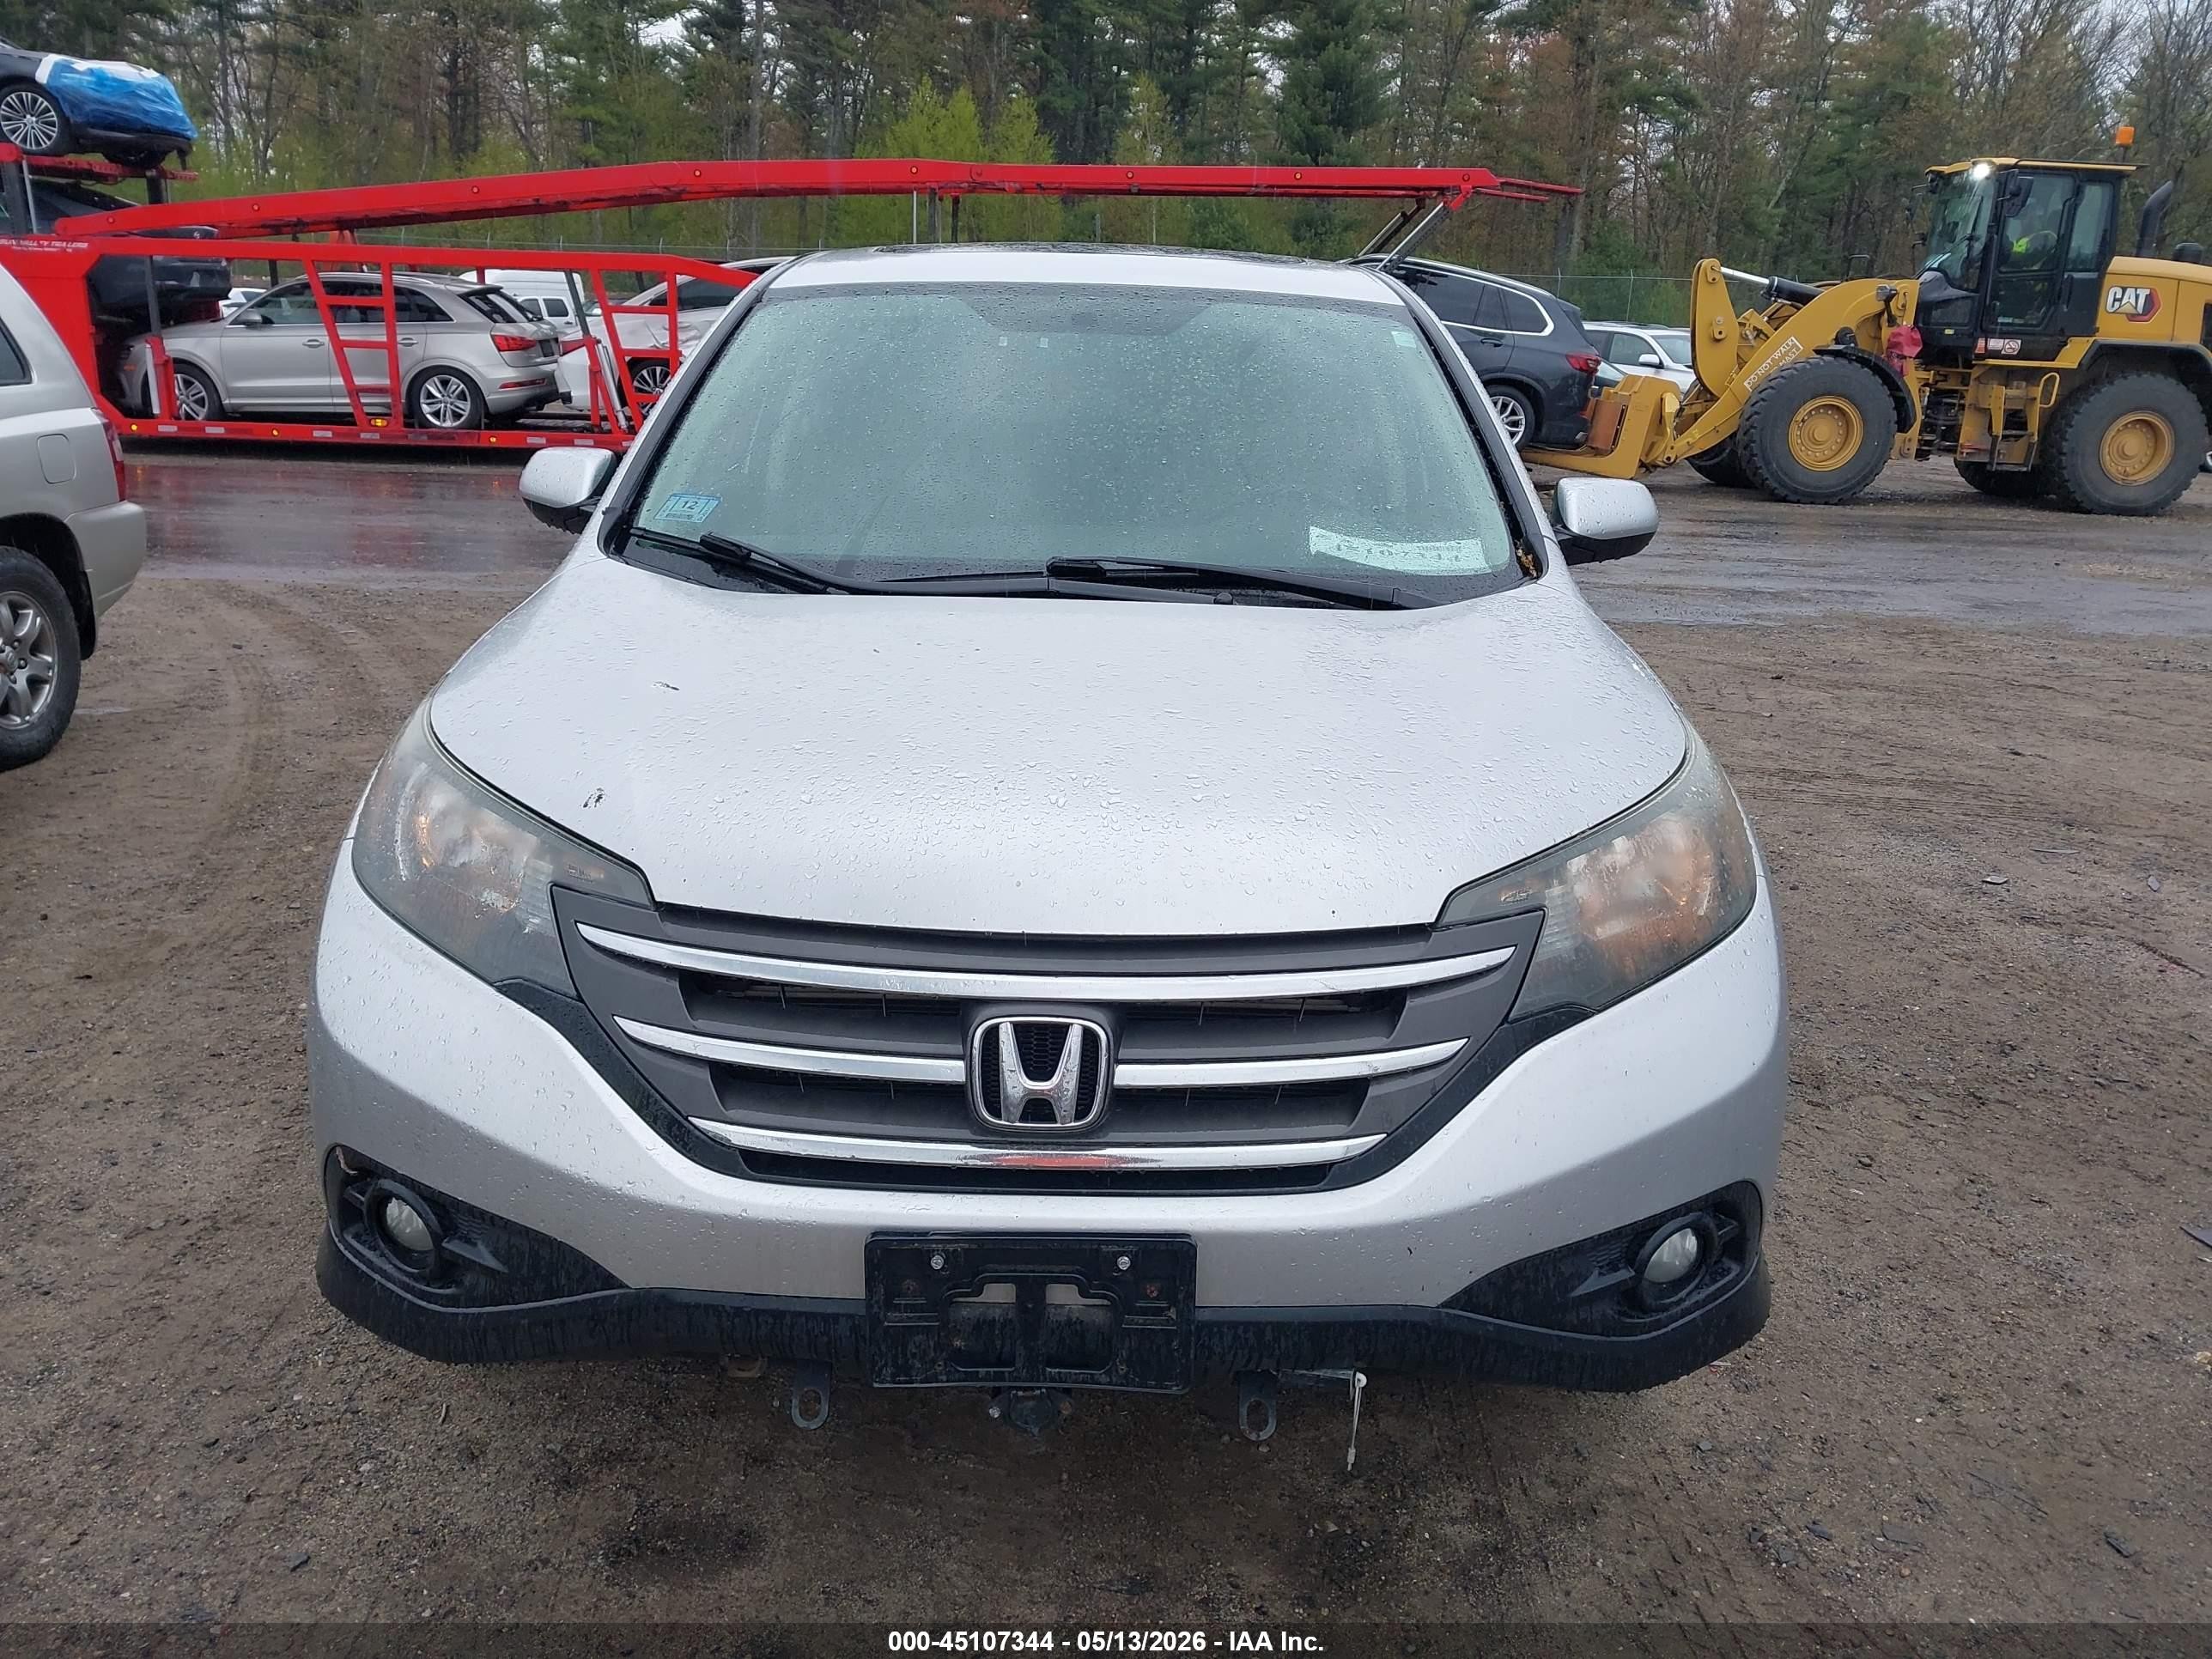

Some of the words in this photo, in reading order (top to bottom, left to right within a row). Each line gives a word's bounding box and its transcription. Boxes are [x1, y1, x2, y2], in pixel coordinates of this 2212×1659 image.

[2106, 286, 2151, 314] CAT
[1747, 375, 1758, 387] DO
[1758, 358, 1773, 375] NOT
[1772, 338, 1795, 360] WALK
[682, 501, 698, 509] 12
